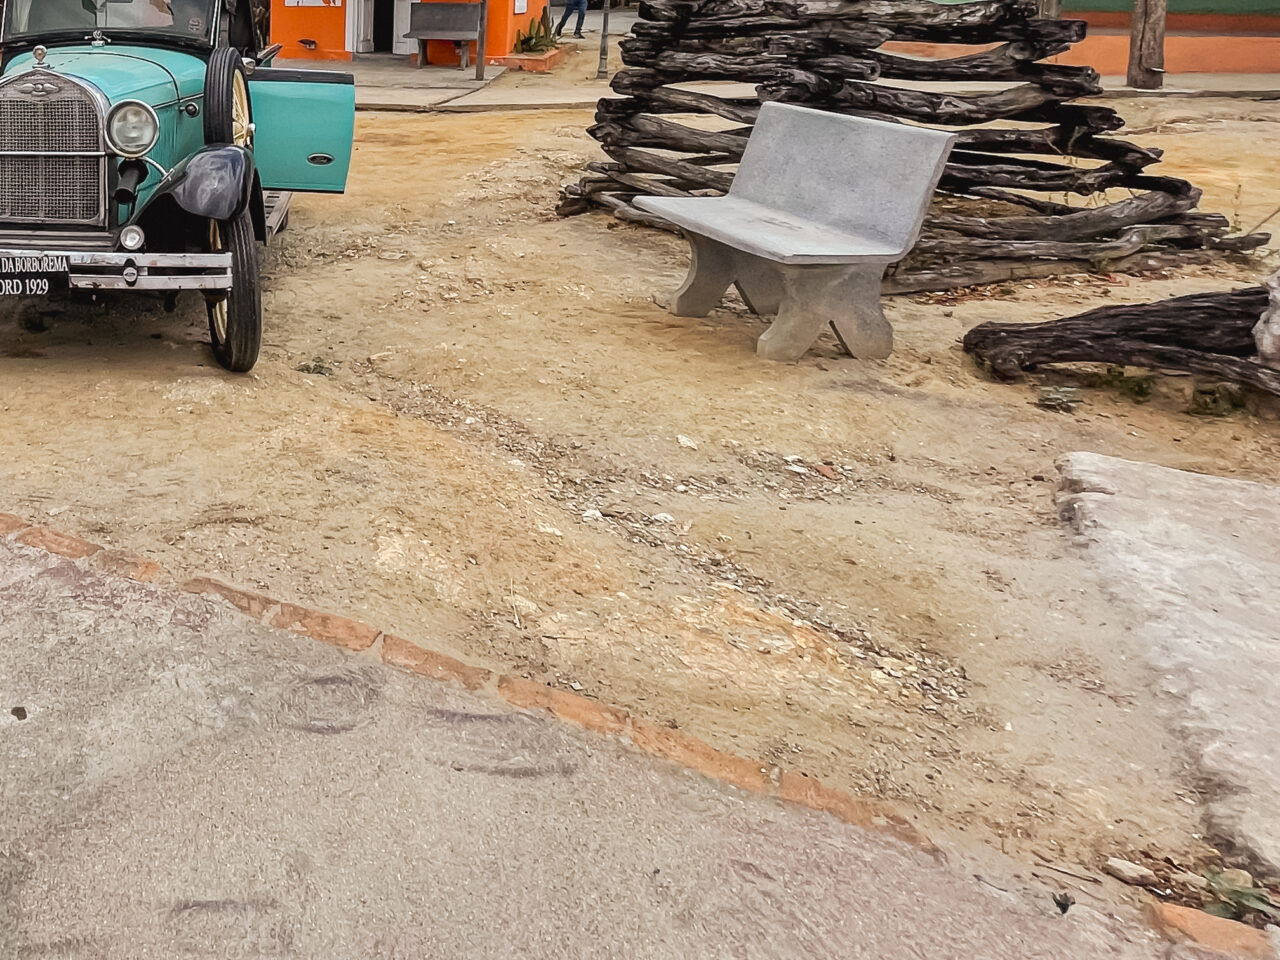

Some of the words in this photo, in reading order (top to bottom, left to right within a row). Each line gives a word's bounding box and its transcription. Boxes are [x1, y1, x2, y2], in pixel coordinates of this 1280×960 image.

[2, 257, 15, 273] DA
[15, 256, 69, 273] BORBOREMA
[25, 278, 49, 295] 1929
